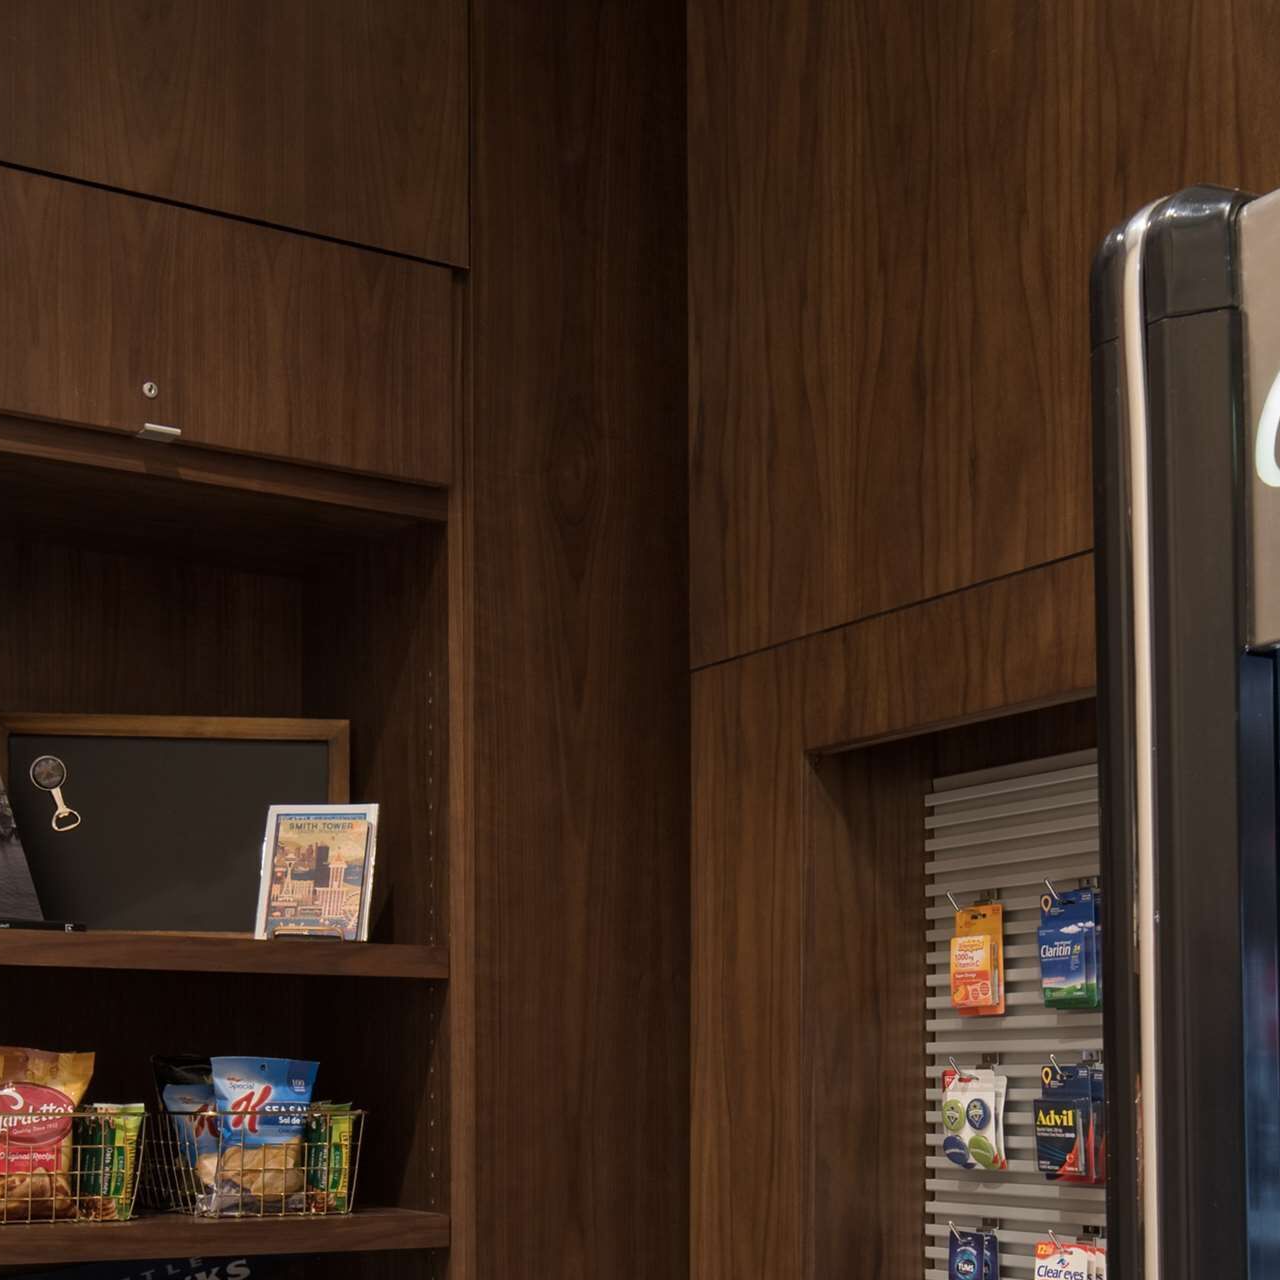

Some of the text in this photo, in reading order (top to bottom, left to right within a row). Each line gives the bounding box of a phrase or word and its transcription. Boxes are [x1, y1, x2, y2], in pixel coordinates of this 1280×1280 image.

[289, 822, 354, 830] SMITH TOWER
[1041, 945, 1071, 957] Claritin
[229, 1082, 255, 1091] Special
[231, 1084, 273, 1134] K
[1036, 1109, 1074, 1127] Advil
[1037, 1264, 1062, 1279] Clear
